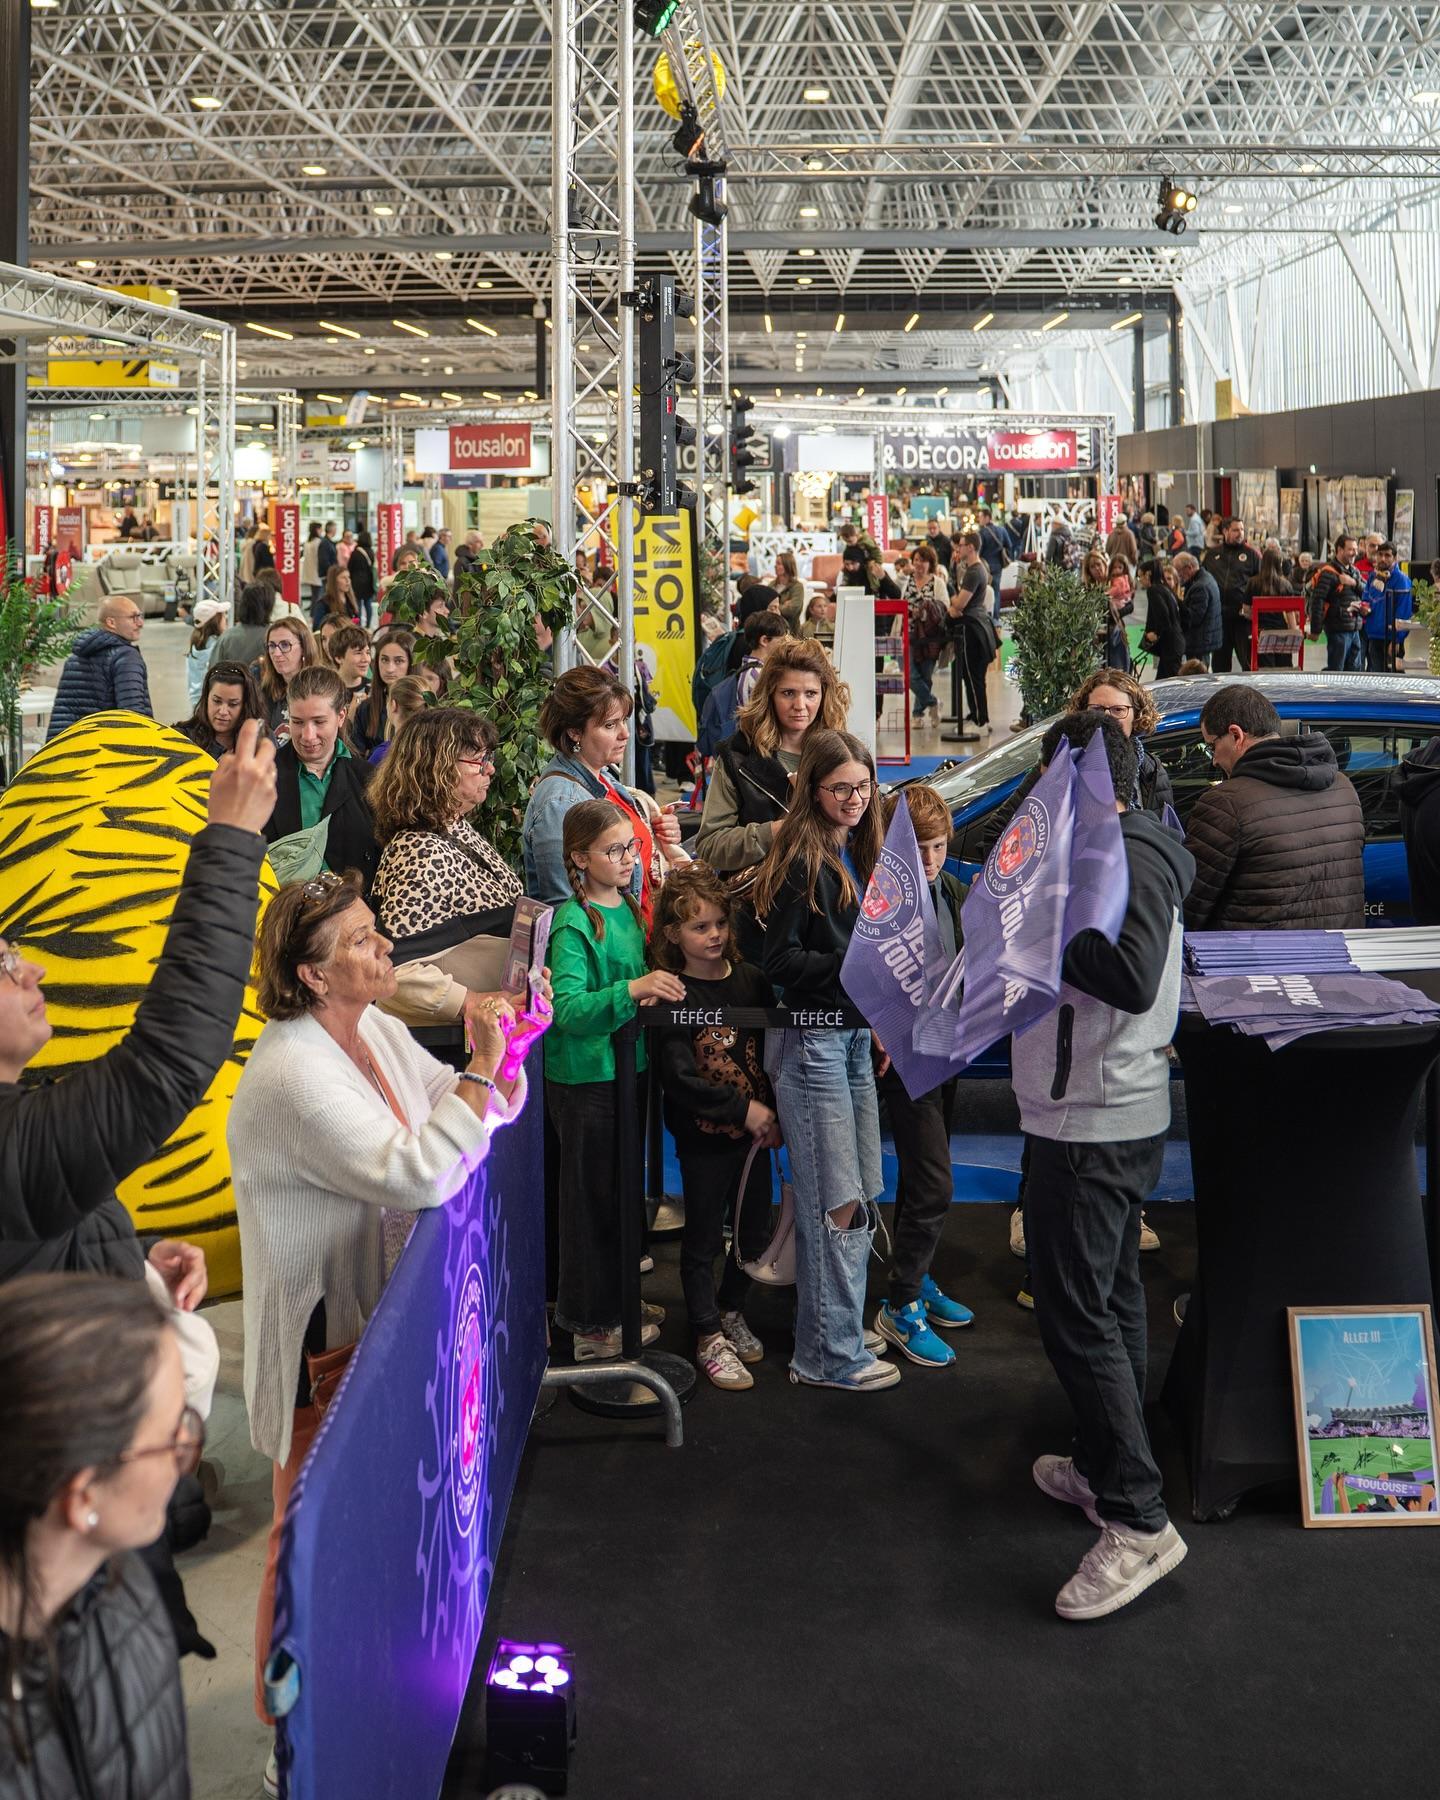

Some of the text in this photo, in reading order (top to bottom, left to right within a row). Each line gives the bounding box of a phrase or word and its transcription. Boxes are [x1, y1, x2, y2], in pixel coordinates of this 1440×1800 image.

[454, 432, 526, 458] tousalon
[882, 440, 990, 470] & DÉCORA
[281, 509, 295, 575] tousalon
[380, 510, 388, 577] tousalon
[1027, 802, 1046, 859] TOULOUSE
[880, 852, 914, 907] TOULOUSE
[991, 880, 1008, 893] CLUB
[1364, 902, 1385, 916] ÉCÉ
[857, 921, 881, 936] CLUB
[670, 1007, 723, 1025] TÉFÉCÉ
[790, 1009, 844, 1026] TÉFÉCÉ
[1343, 1330, 1368, 1344] ALLEZ
[1357, 1478, 1409, 1494] TOULOUSE
